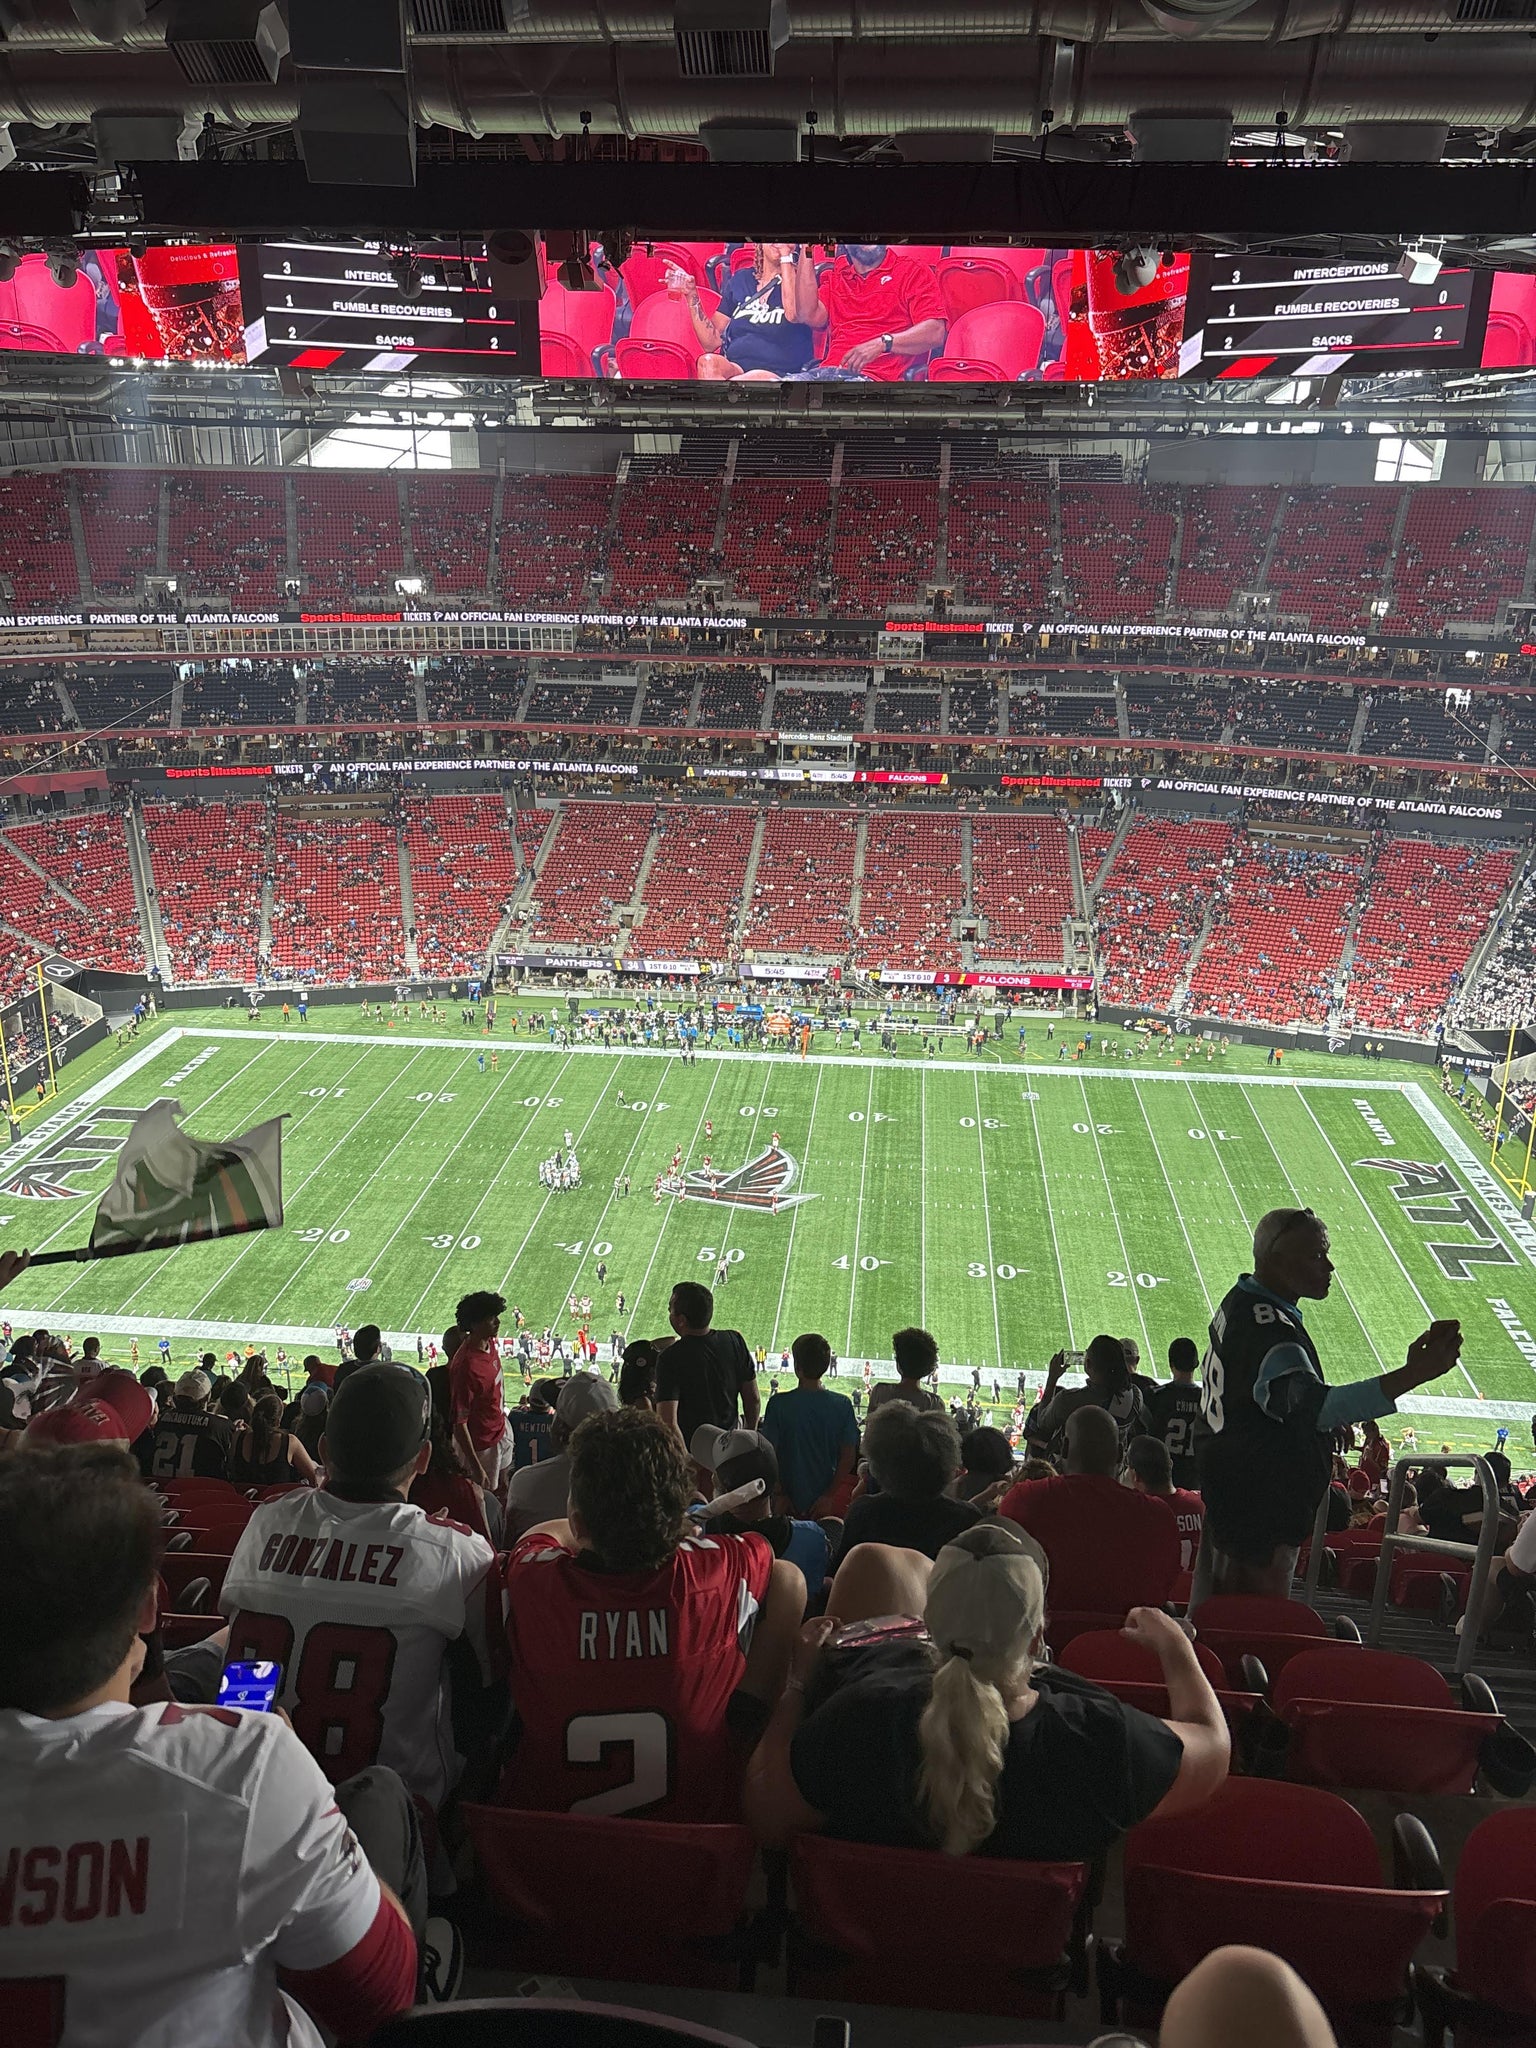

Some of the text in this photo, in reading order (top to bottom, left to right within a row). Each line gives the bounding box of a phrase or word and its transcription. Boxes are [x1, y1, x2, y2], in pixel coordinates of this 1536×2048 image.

[283, 262, 291, 275] 3
[1293, 263, 1389, 280] INTERCEPTIONS
[345, 269, 436, 285] INTERCENS
[1232, 270, 1241, 284] 3
[285, 295, 294, 307] 1
[1438, 290, 1448, 304] 0
[333, 301, 452, 317] FUMBLE RECOVERIES
[488, 306, 498, 319] 0
[1228, 304, 1236, 317] 1
[1274, 297, 1400, 315] FUMBLE RECOVERIES
[288, 326, 297, 339] 2
[1433, 326, 1443, 340] 2
[375, 335, 415, 347] SACKS
[490, 337, 499, 350] 2
[1224, 336, 1233, 350] 2
[1311, 335, 1353, 347] SACKS
[16, 614, 83, 627] EXPERIENCE
[90, 614, 138, 625] PARTNER
[139, 613, 155, 624] OF
[156, 613, 178, 624] THE
[185, 613, 230, 624] ATLANTA
[232, 613, 279, 624] FALCONS
[300, 611, 747, 628] Sports Illustrated TICKETS AN OFFICIAL FAN EXPERIENCE PARTNER OF THE ATLANTA FALCONS
[885, 620, 1366, 646] Sports Illustrated TICKETS AN OFFICIAL FAN EXPERIENCE PARTNER OF THE ATLANTA FALCONS
[778, 732, 825, 740] Mercedes-Benz
[826, 733, 853, 741] Stadium
[166, 760, 638, 778] Sports Illustrated TICKETS AN OFFICIAL FAN EXPERIENCE PARTNER OF THE ATLANTA FALCONS
[703, 769, 747, 777] PANTHERS
[861, 772, 867, 780] 3
[888, 774, 927, 782] FALCONS
[1001, 775, 1502, 819] Sports Illustrated TICKETS AN OFFICIAL FAN EXPERIENCE PARTNER OF THE ATLANTA FALCONS
[545, 958, 604, 968] PANTHERS
[627, 961, 639, 970] 34
[764, 967, 785, 975] 5:45
[943, 973, 950, 983] 3
[978, 975, 1031, 985] FALCONS
[161, 1046, 221, 1088] FALCONS
[1441, 1054, 1497, 1069] THE NEST
[28, 1101, 92, 1139] CHANGE
[1351, 1098, 1397, 1146] ATLANTA
[1471, 1175, 1513, 1211] TAKES
[1501, 1215, 1535, 1239] ALL
[298, 1228, 351, 1243] 20
[431, 1234, 482, 1250] 30
[564, 1240, 613, 1256] 40
[696, 1247, 745, 1263] 50
[831, 1254, 880, 1271] 40
[966, 1262, 1017, 1280] 30
[1106, 1271, 1158, 1289] 20
[519, 1422, 551, 1433] NEWTON
[1164, 1418, 1196, 1457] 21
[151, 1431, 199, 1478] 21
[528, 1438, 538, 1465] 1
[258, 1531, 406, 1588] GONZALEZ
[579, 1608, 668, 1660] RYAN
[566, 1709, 669, 1817] 2
